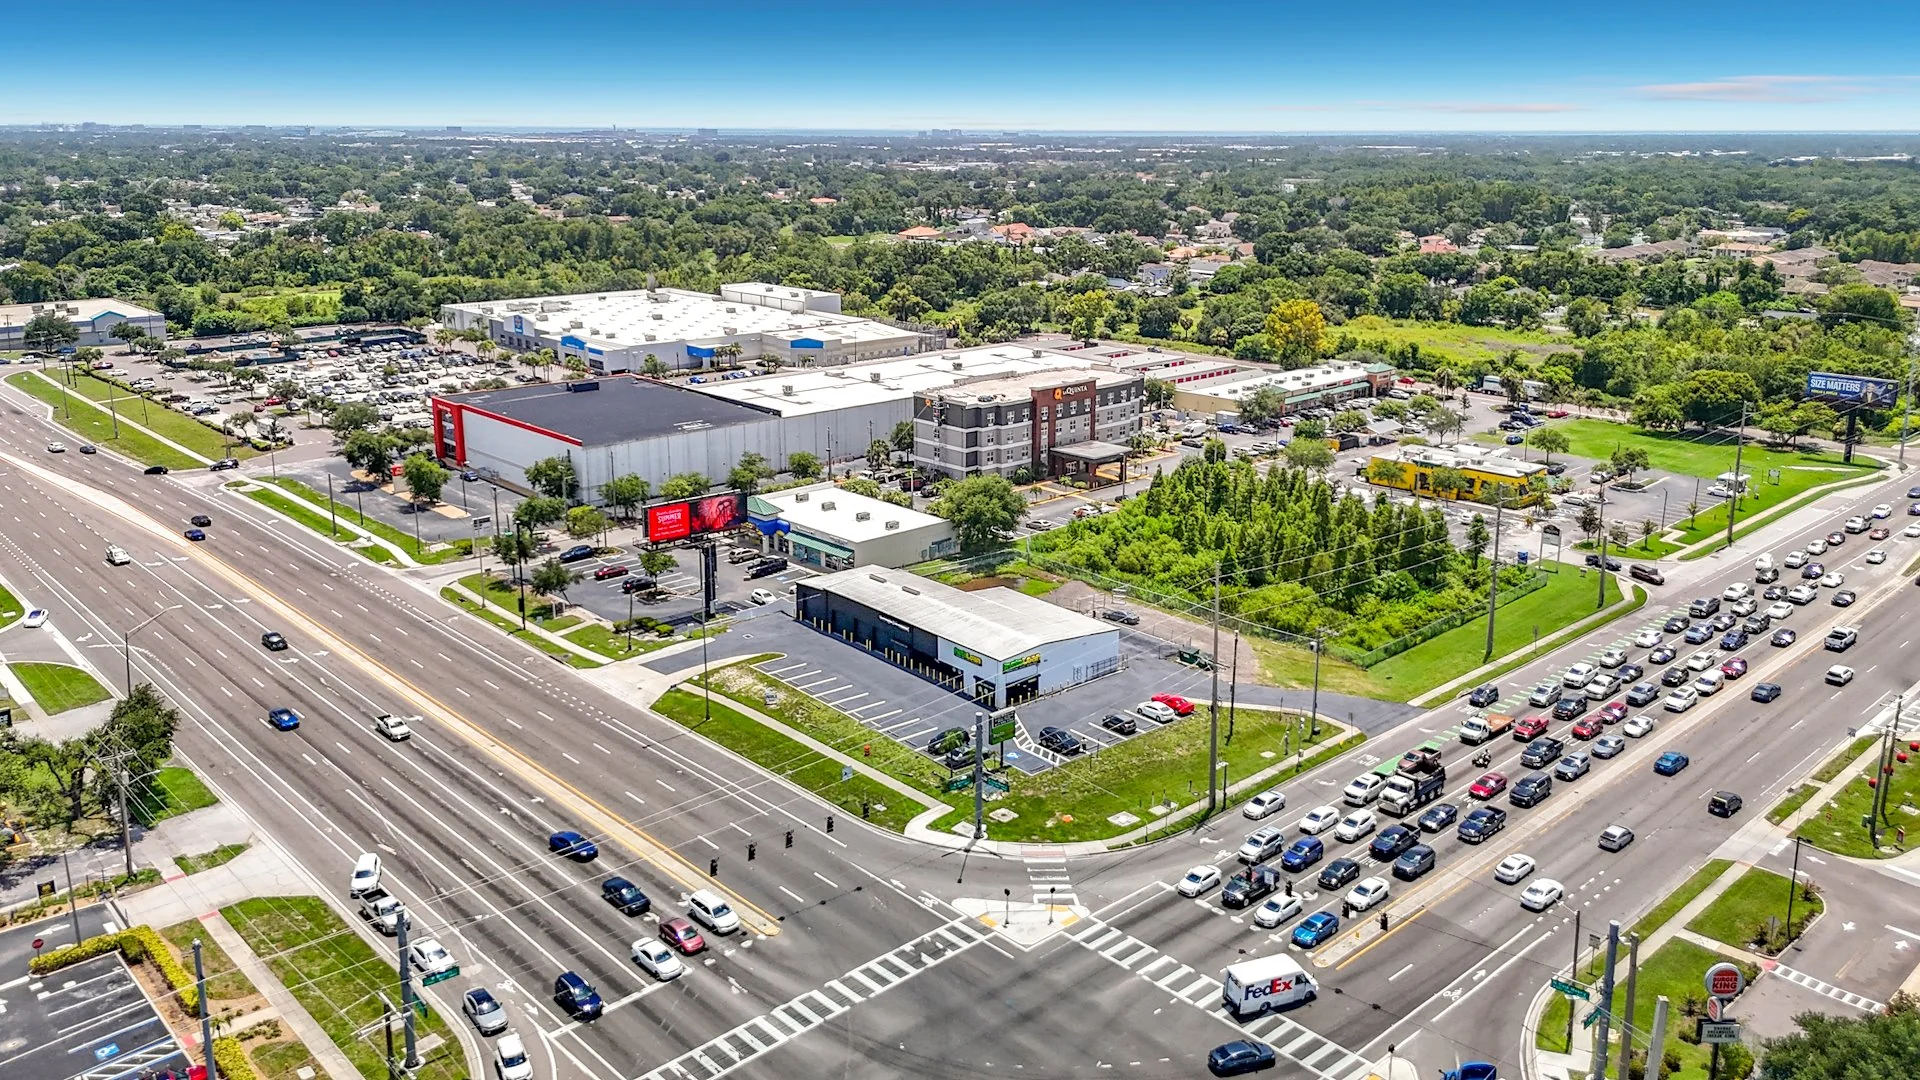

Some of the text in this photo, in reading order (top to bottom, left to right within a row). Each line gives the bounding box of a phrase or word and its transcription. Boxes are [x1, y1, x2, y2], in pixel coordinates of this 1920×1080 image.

[1810, 379, 1826, 389] SIZE
[1827, 380, 1860, 392] MATTERS
[657, 512, 682, 523] SUMMER
[1244, 977, 1293, 1000] FedEx
